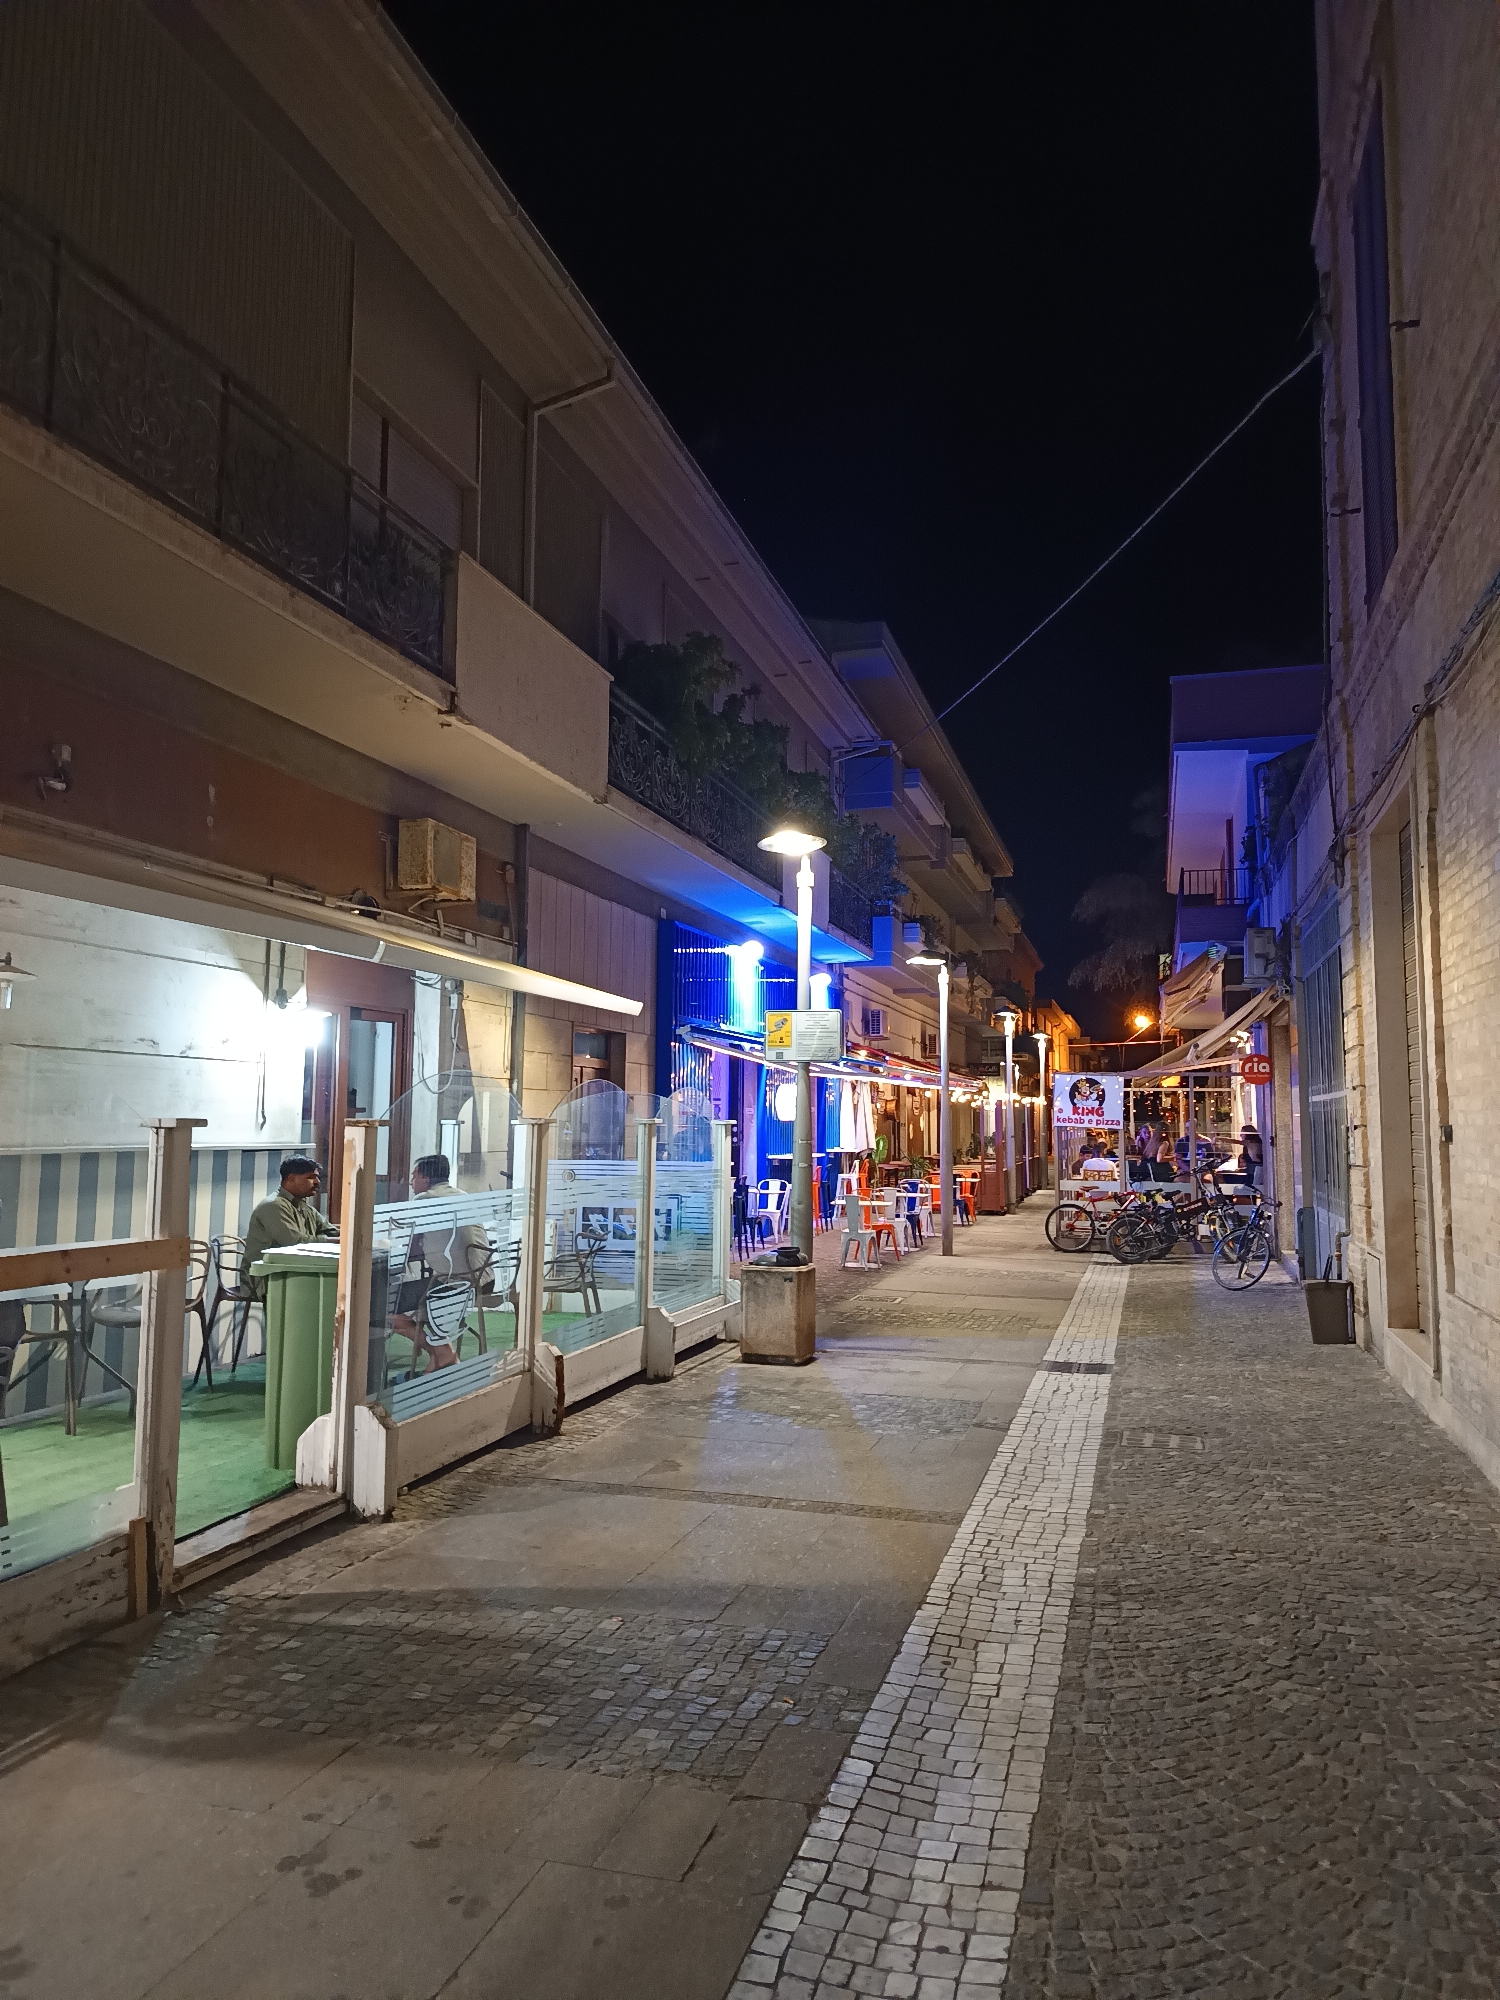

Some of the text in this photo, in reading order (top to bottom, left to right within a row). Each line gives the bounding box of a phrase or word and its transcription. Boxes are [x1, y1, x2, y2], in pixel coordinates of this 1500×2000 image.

[1244, 1057, 1270, 1073] ria
[1072, 1105, 1105, 1118] KING
[1056, 1116, 1085, 1125] kebab
[1095, 1118, 1121, 1126] pizza
